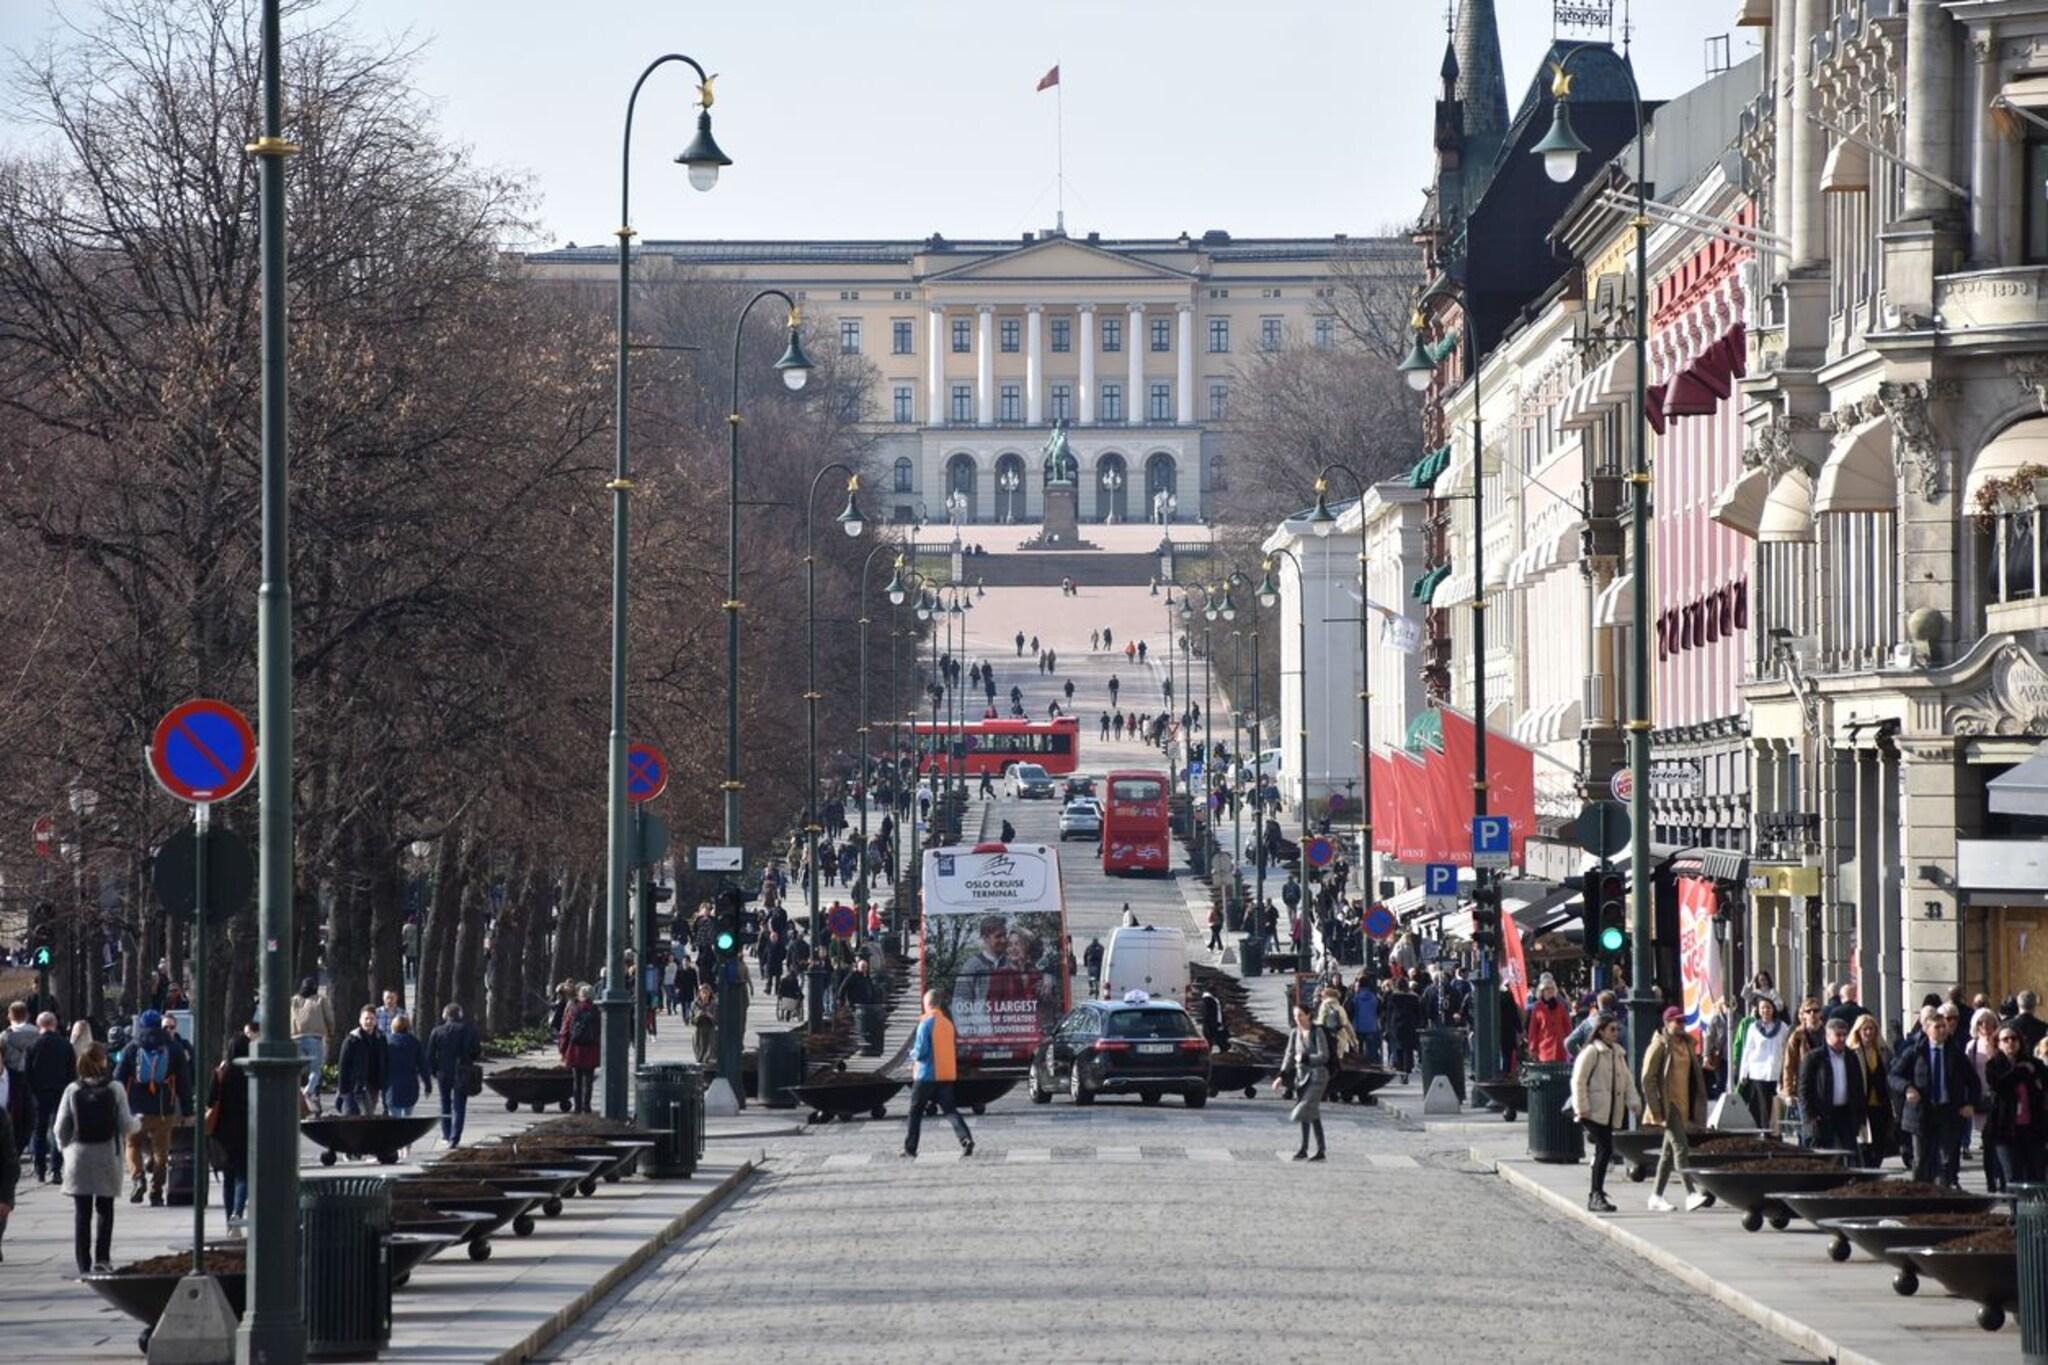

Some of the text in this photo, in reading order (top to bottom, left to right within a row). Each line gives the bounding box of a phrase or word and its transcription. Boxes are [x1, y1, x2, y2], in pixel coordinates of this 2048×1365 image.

[1481, 821, 1500, 849] P
[964, 880, 1025, 889] OSLO CRUISE
[1432, 868, 1450, 892] P
[972, 889, 1018, 899] TERMINAL
[994, 1000, 1038, 1012] LARGEST
